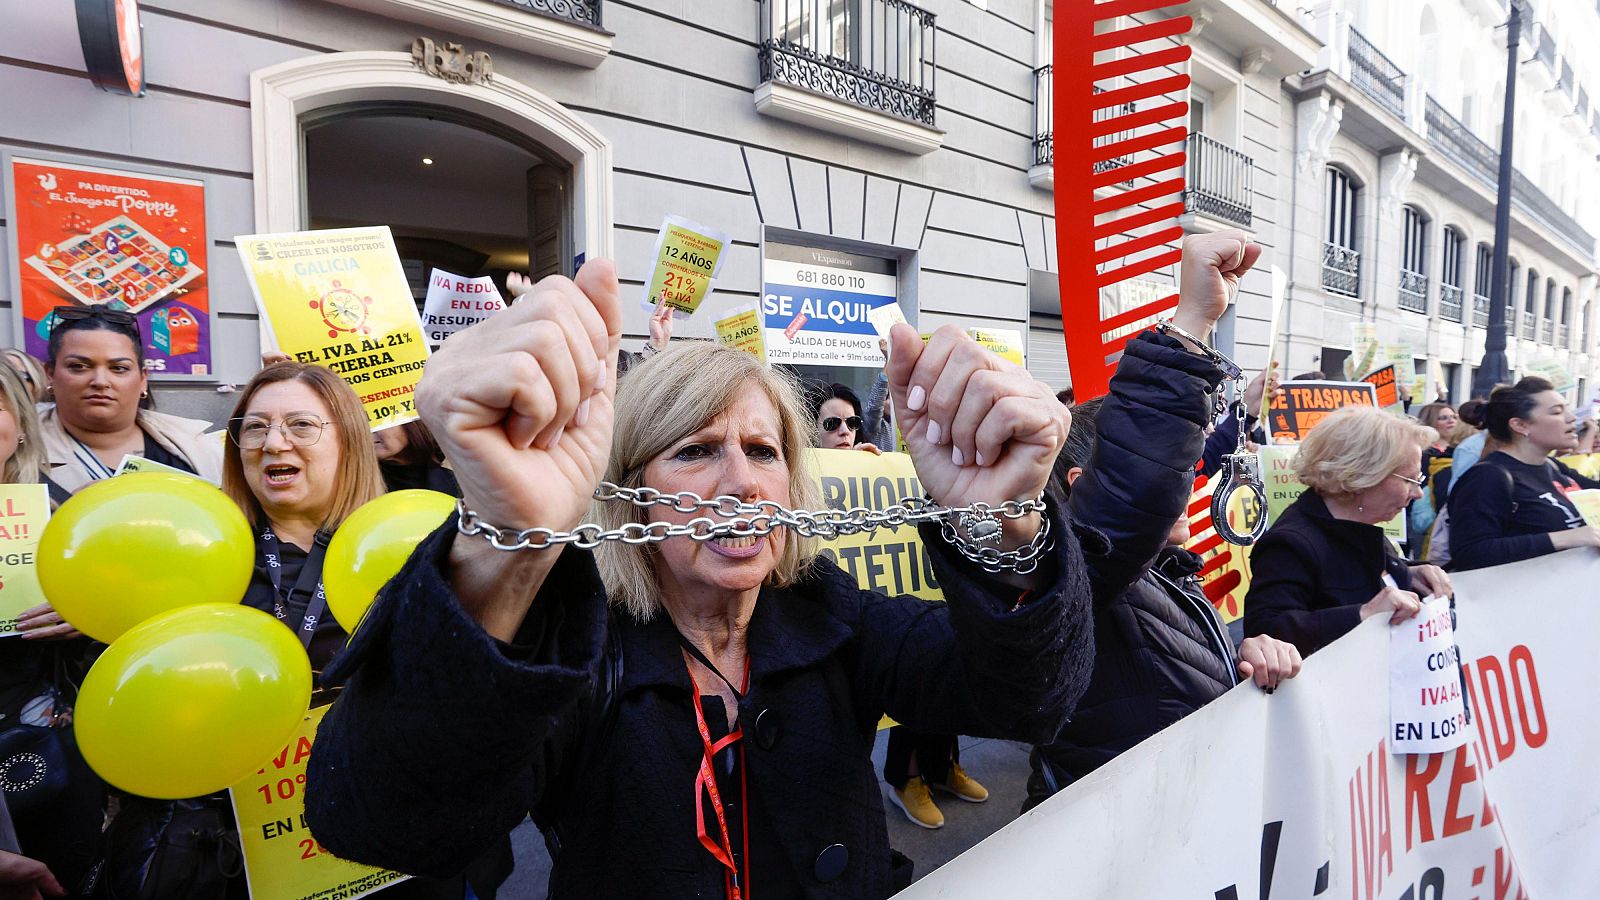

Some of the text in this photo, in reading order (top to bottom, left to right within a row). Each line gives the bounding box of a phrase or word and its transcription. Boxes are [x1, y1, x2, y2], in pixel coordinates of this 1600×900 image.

[78, 182, 151, 198] PA DIVERTIDO,
[49, 192, 63, 201] EL
[104, 199, 119, 207] DE
[114, 195, 178, 218] Poppy
[276, 242, 386, 259] CREER EN NOSOTROS
[665, 246, 713, 271] 12 AÑOS
[294, 256, 361, 277] GALICIA
[433, 275, 451, 290] IVA
[664, 271, 696, 293] 21%
[796, 270, 865, 289] 681 880 110
[451, 300, 502, 310] EN LOS
[675, 292, 691, 304] IVA
[763, 294, 793, 317] SE
[424, 313, 488, 326] RESUP
[735, 325, 759, 340] AÑOS
[789, 336, 872, 349] SALIDA DE HUMOS
[295, 333, 412, 365] EL IVA AL 21%
[793, 350, 819, 359] planta
[820, 352, 839, 360] calle
[328, 352, 395, 374] CIERRA
[360, 383, 417, 404] ESENCIAL
[1290, 387, 1373, 409] TRASPASA
[373, 405, 399, 420] 10%
[1273, 473, 1299, 484] 10%
[1273, 491, 1287, 499] EN
[0, 499, 25, 517] L
[0, 552, 33, 566] GE
[1421, 680, 1461, 706] IVA AL
[1395, 722, 1423, 741] EN
[1431, 716, 1457, 740] LOS
[257, 736, 313, 775] VA
[1349, 736, 1394, 900] IVA
[262, 817, 293, 840] EN
[299, 838, 328, 860] 2
[295, 887, 336, 900] taforma
[347, 873, 375, 887] imagen
[332, 890, 347, 900] EN
